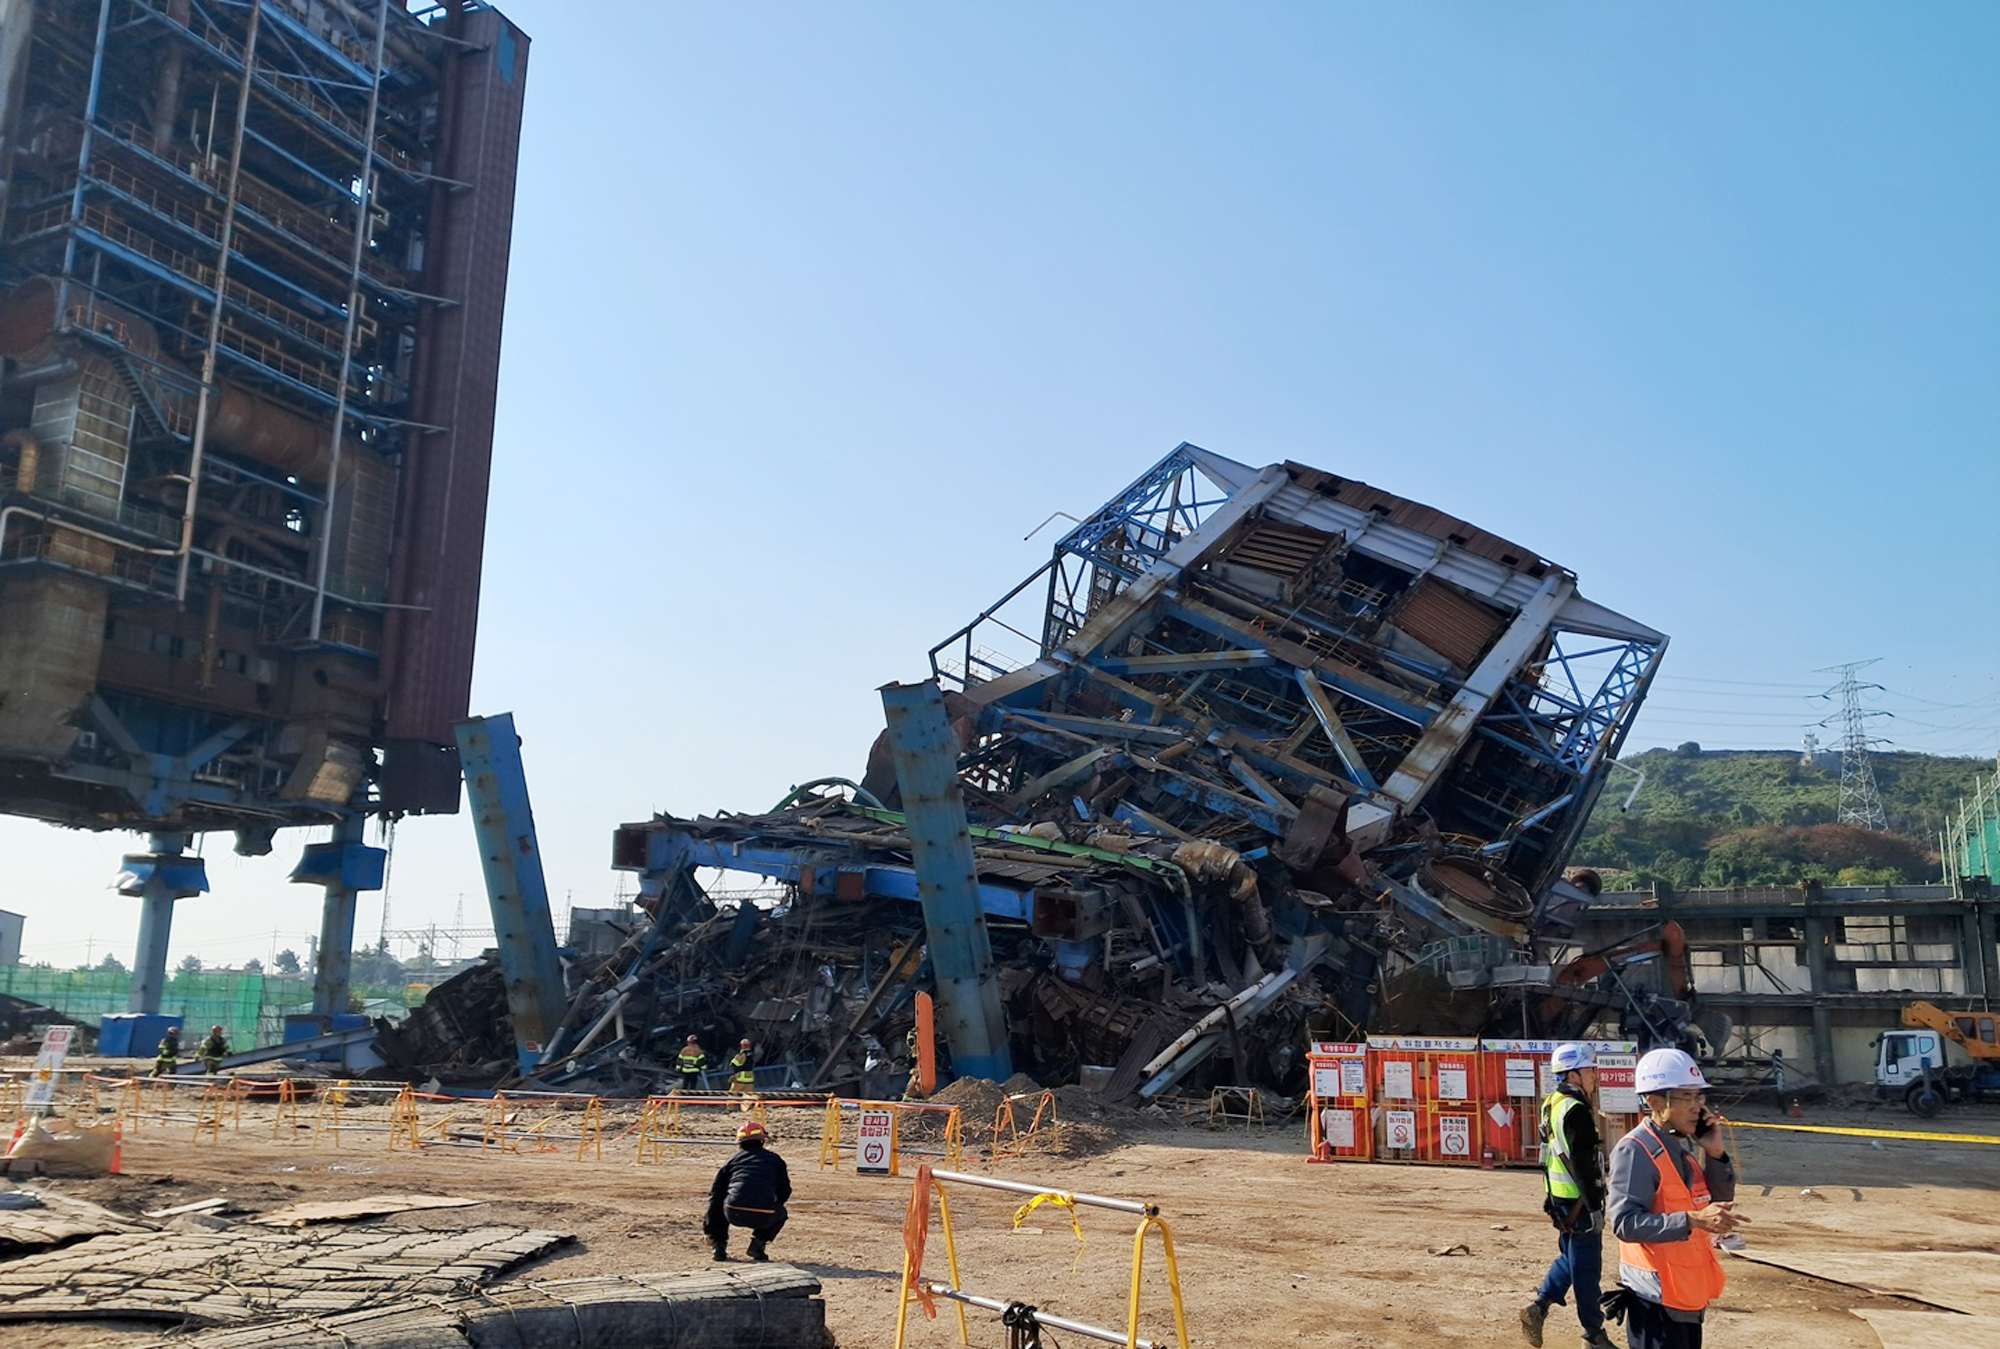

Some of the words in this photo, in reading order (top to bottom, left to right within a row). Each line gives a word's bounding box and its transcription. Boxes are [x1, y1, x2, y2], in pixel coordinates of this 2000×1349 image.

[1404, 1040, 1461, 1048] 위험물저장소
[1527, 1041, 1612, 1051] 위험장소
[1599, 1071, 1635, 1083] 화기엄금
[865, 1116, 887, 1125] 공사중
[860, 1127, 890, 1137] 출입금지
